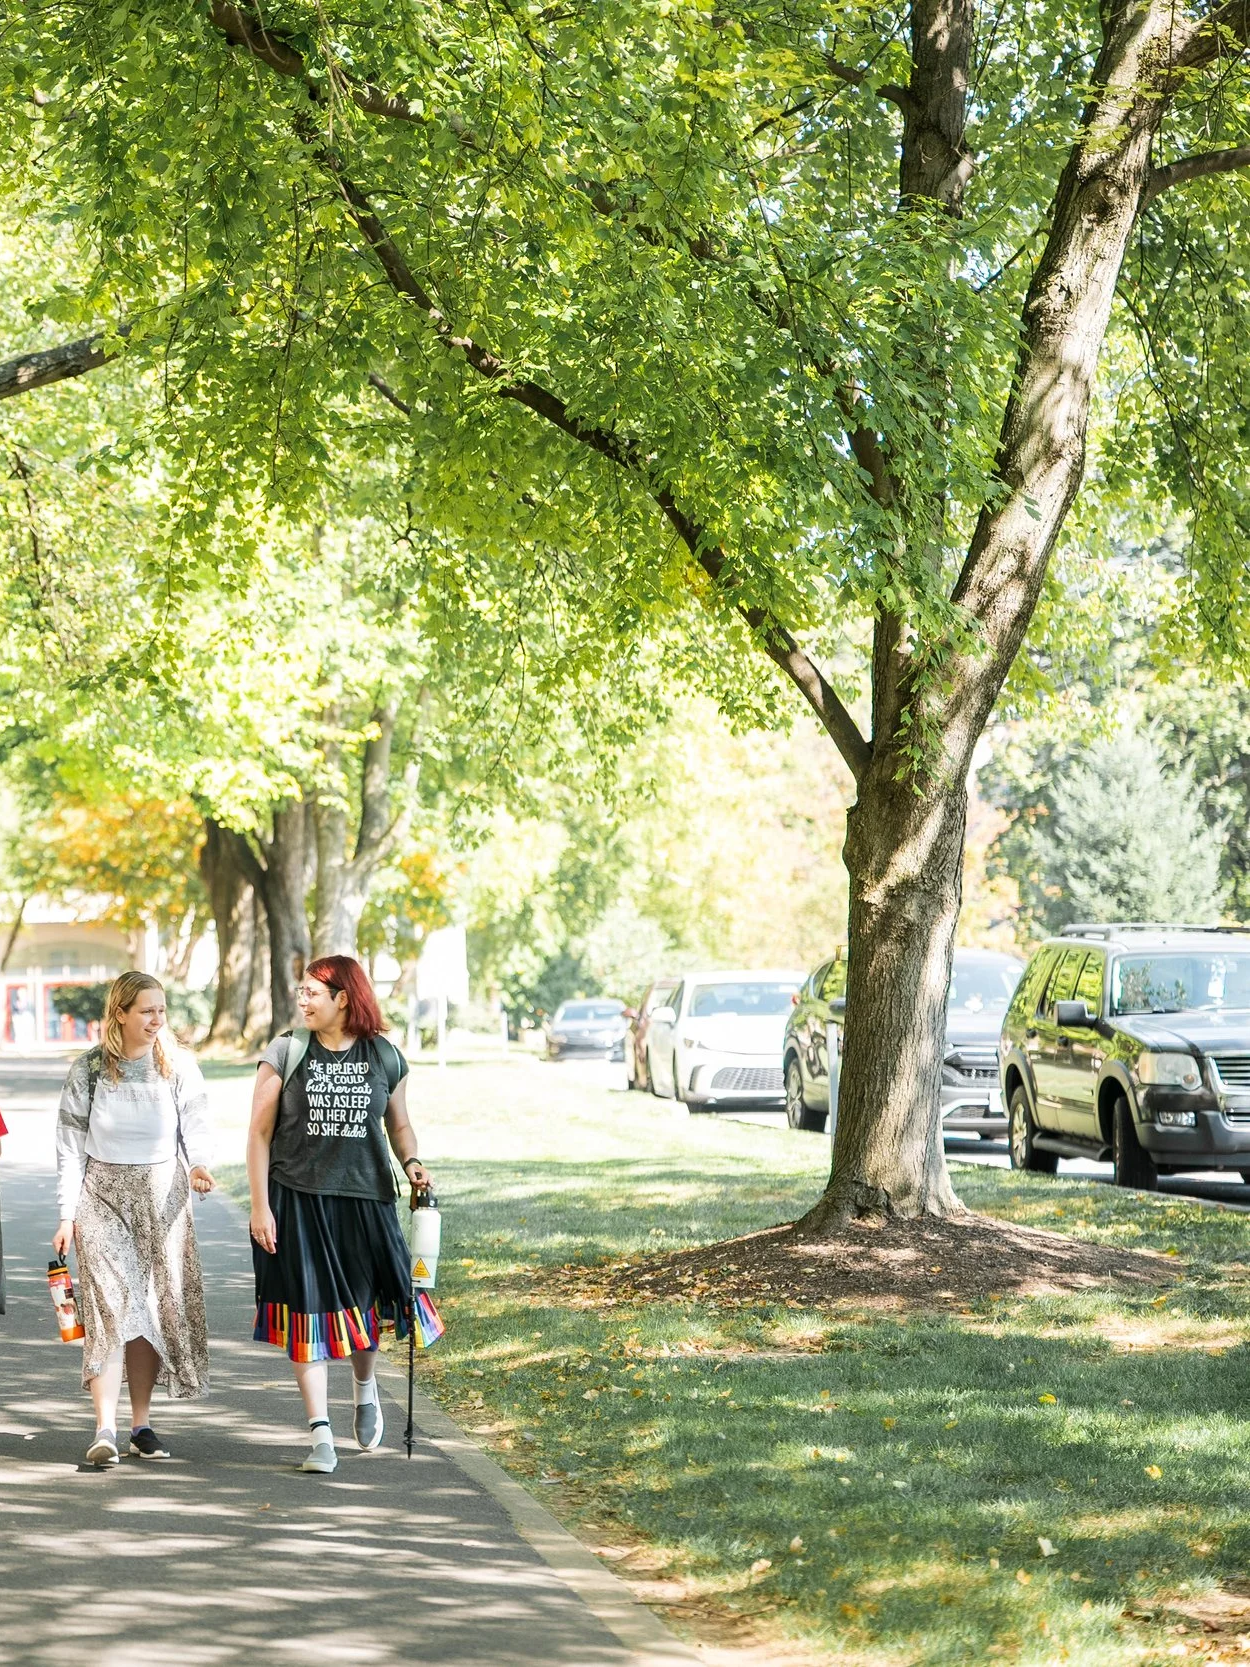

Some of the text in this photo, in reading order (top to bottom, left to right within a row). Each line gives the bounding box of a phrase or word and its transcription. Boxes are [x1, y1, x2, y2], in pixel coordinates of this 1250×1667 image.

[326, 1062, 369, 1075] BELIEVED
[313, 1072, 365, 1084] SHE COULD
[305, 1079, 373, 1095] but her cat
[307, 1094, 371, 1109] WAS ASLEEP
[309, 1108, 368, 1124] ON HER LAP
[306, 1122, 368, 1138] SO SHE didn't
